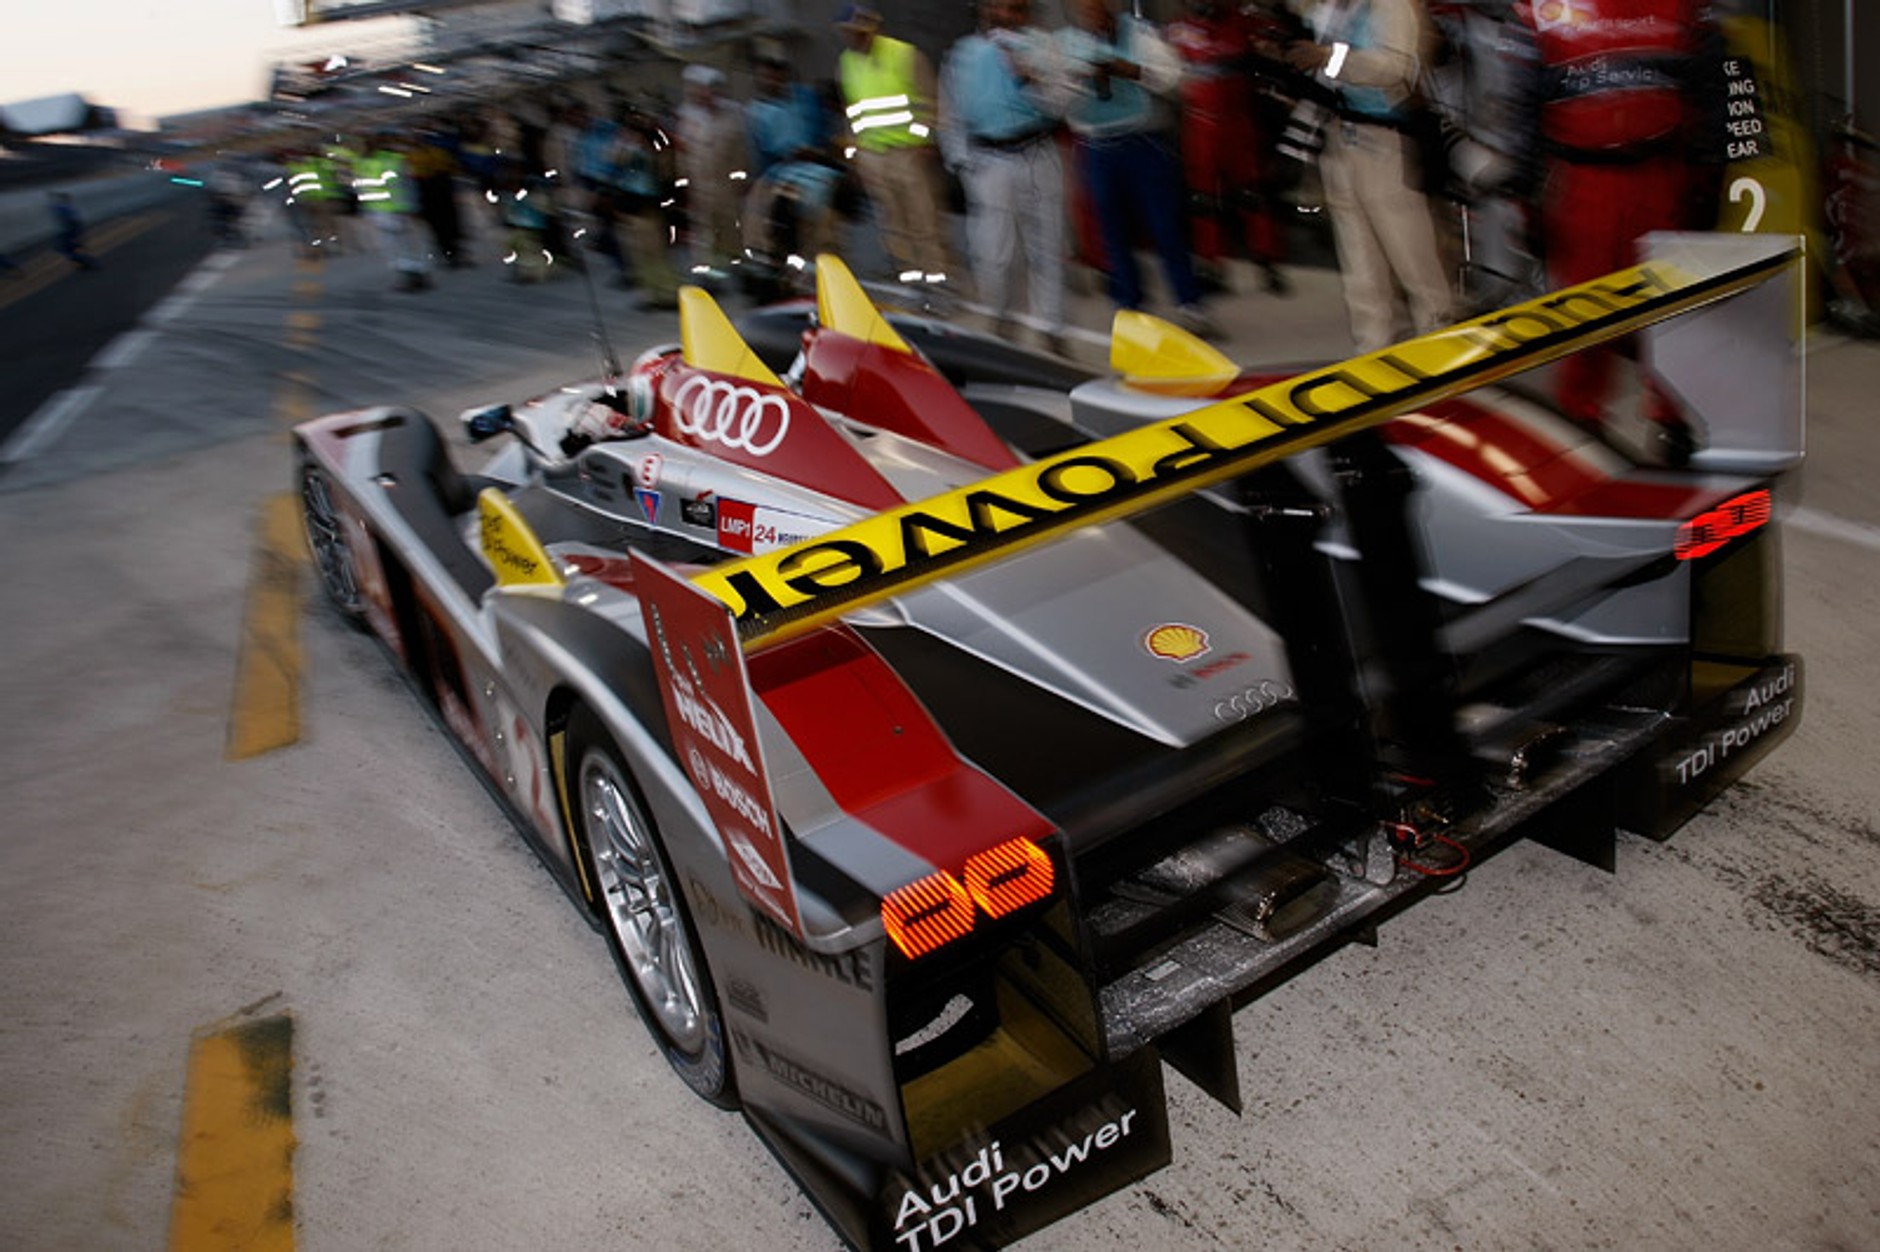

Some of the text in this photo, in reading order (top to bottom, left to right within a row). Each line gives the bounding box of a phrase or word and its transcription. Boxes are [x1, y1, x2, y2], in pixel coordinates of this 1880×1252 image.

[721, 516, 751, 538] LMP1
[730, 421, 1231, 622] Power
[754, 523, 776, 544] 24
[1743, 664, 1795, 716] Audi
[1675, 697, 1792, 784] TDI Power
[707, 760, 774, 840] BOSCH
[769, 1053, 886, 1126] MICHELIN
[894, 1140, 1004, 1231] Audi
[895, 1108, 1137, 1252] TDI Power
